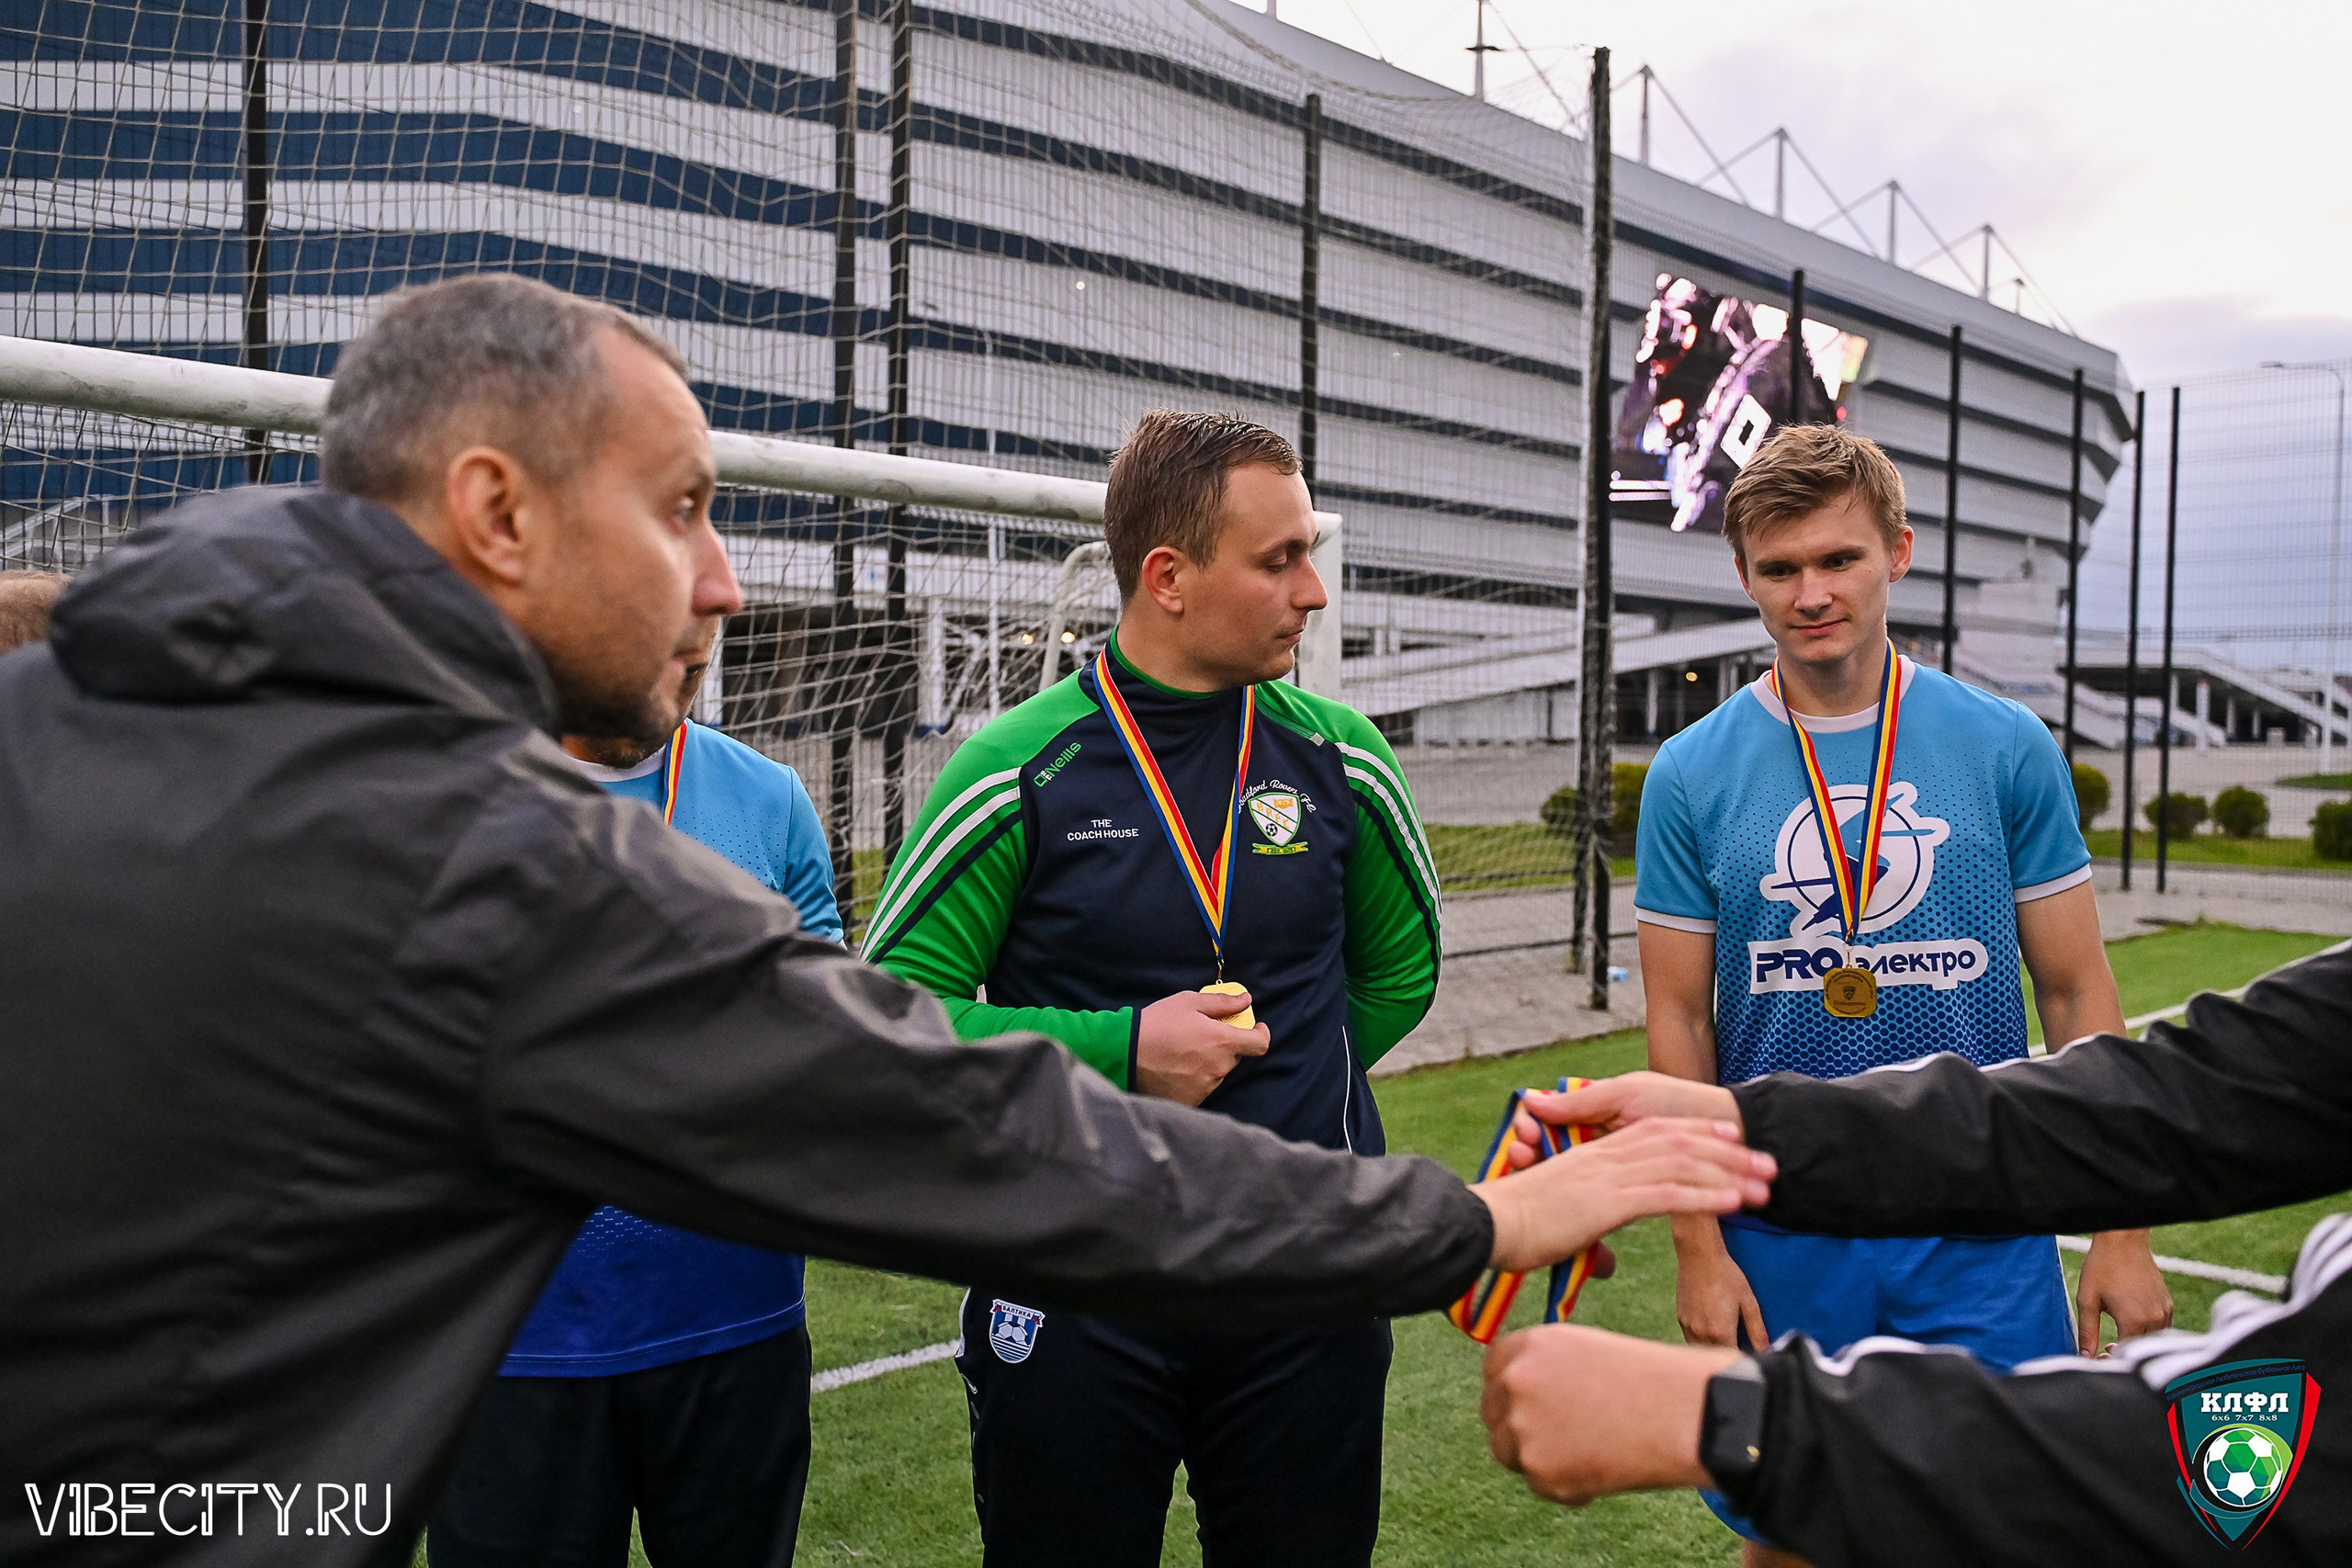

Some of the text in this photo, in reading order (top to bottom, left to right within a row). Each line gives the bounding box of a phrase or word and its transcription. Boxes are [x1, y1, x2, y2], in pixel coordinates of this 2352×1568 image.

[1270, 779, 1298, 795] Rovers
[1091, 818, 1112, 829] THE
[1067, 828, 1139, 841] COACH HOUSE
[1756, 947, 1976, 983] PRO электро
[1002, 1305, 1031, 1317] БАЛТИКА
